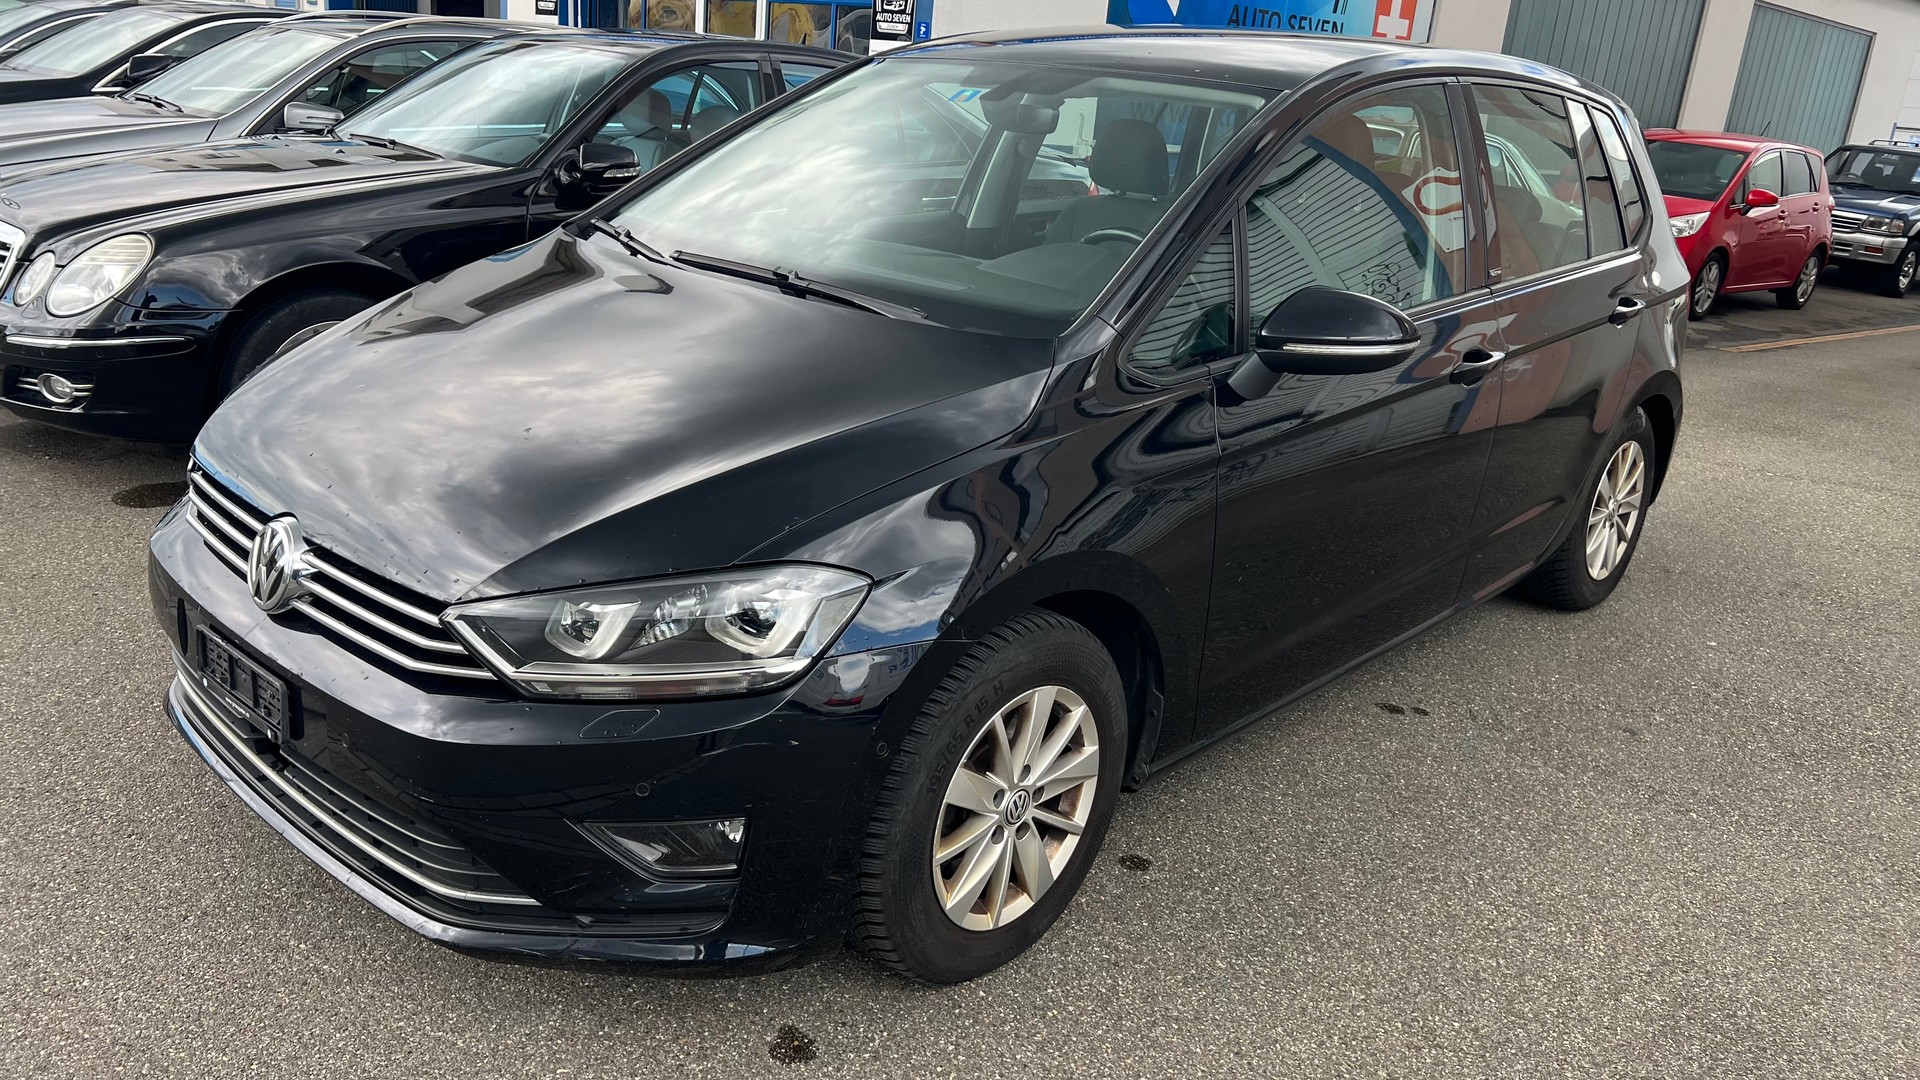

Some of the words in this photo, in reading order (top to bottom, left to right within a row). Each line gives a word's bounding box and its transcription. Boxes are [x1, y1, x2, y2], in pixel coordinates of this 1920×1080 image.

[876, 12, 892, 22] AUTO
[893, 13, 911, 23] SEVEN
[1227, 4, 1281, 28] AUTO
[1288, 14, 1344, 34] SEVEN
[926, 730, 964, 794] 195/65
[963, 713, 976, 730] R
[974, 695, 990, 714] 15
[992, 681, 1004, 697] H
